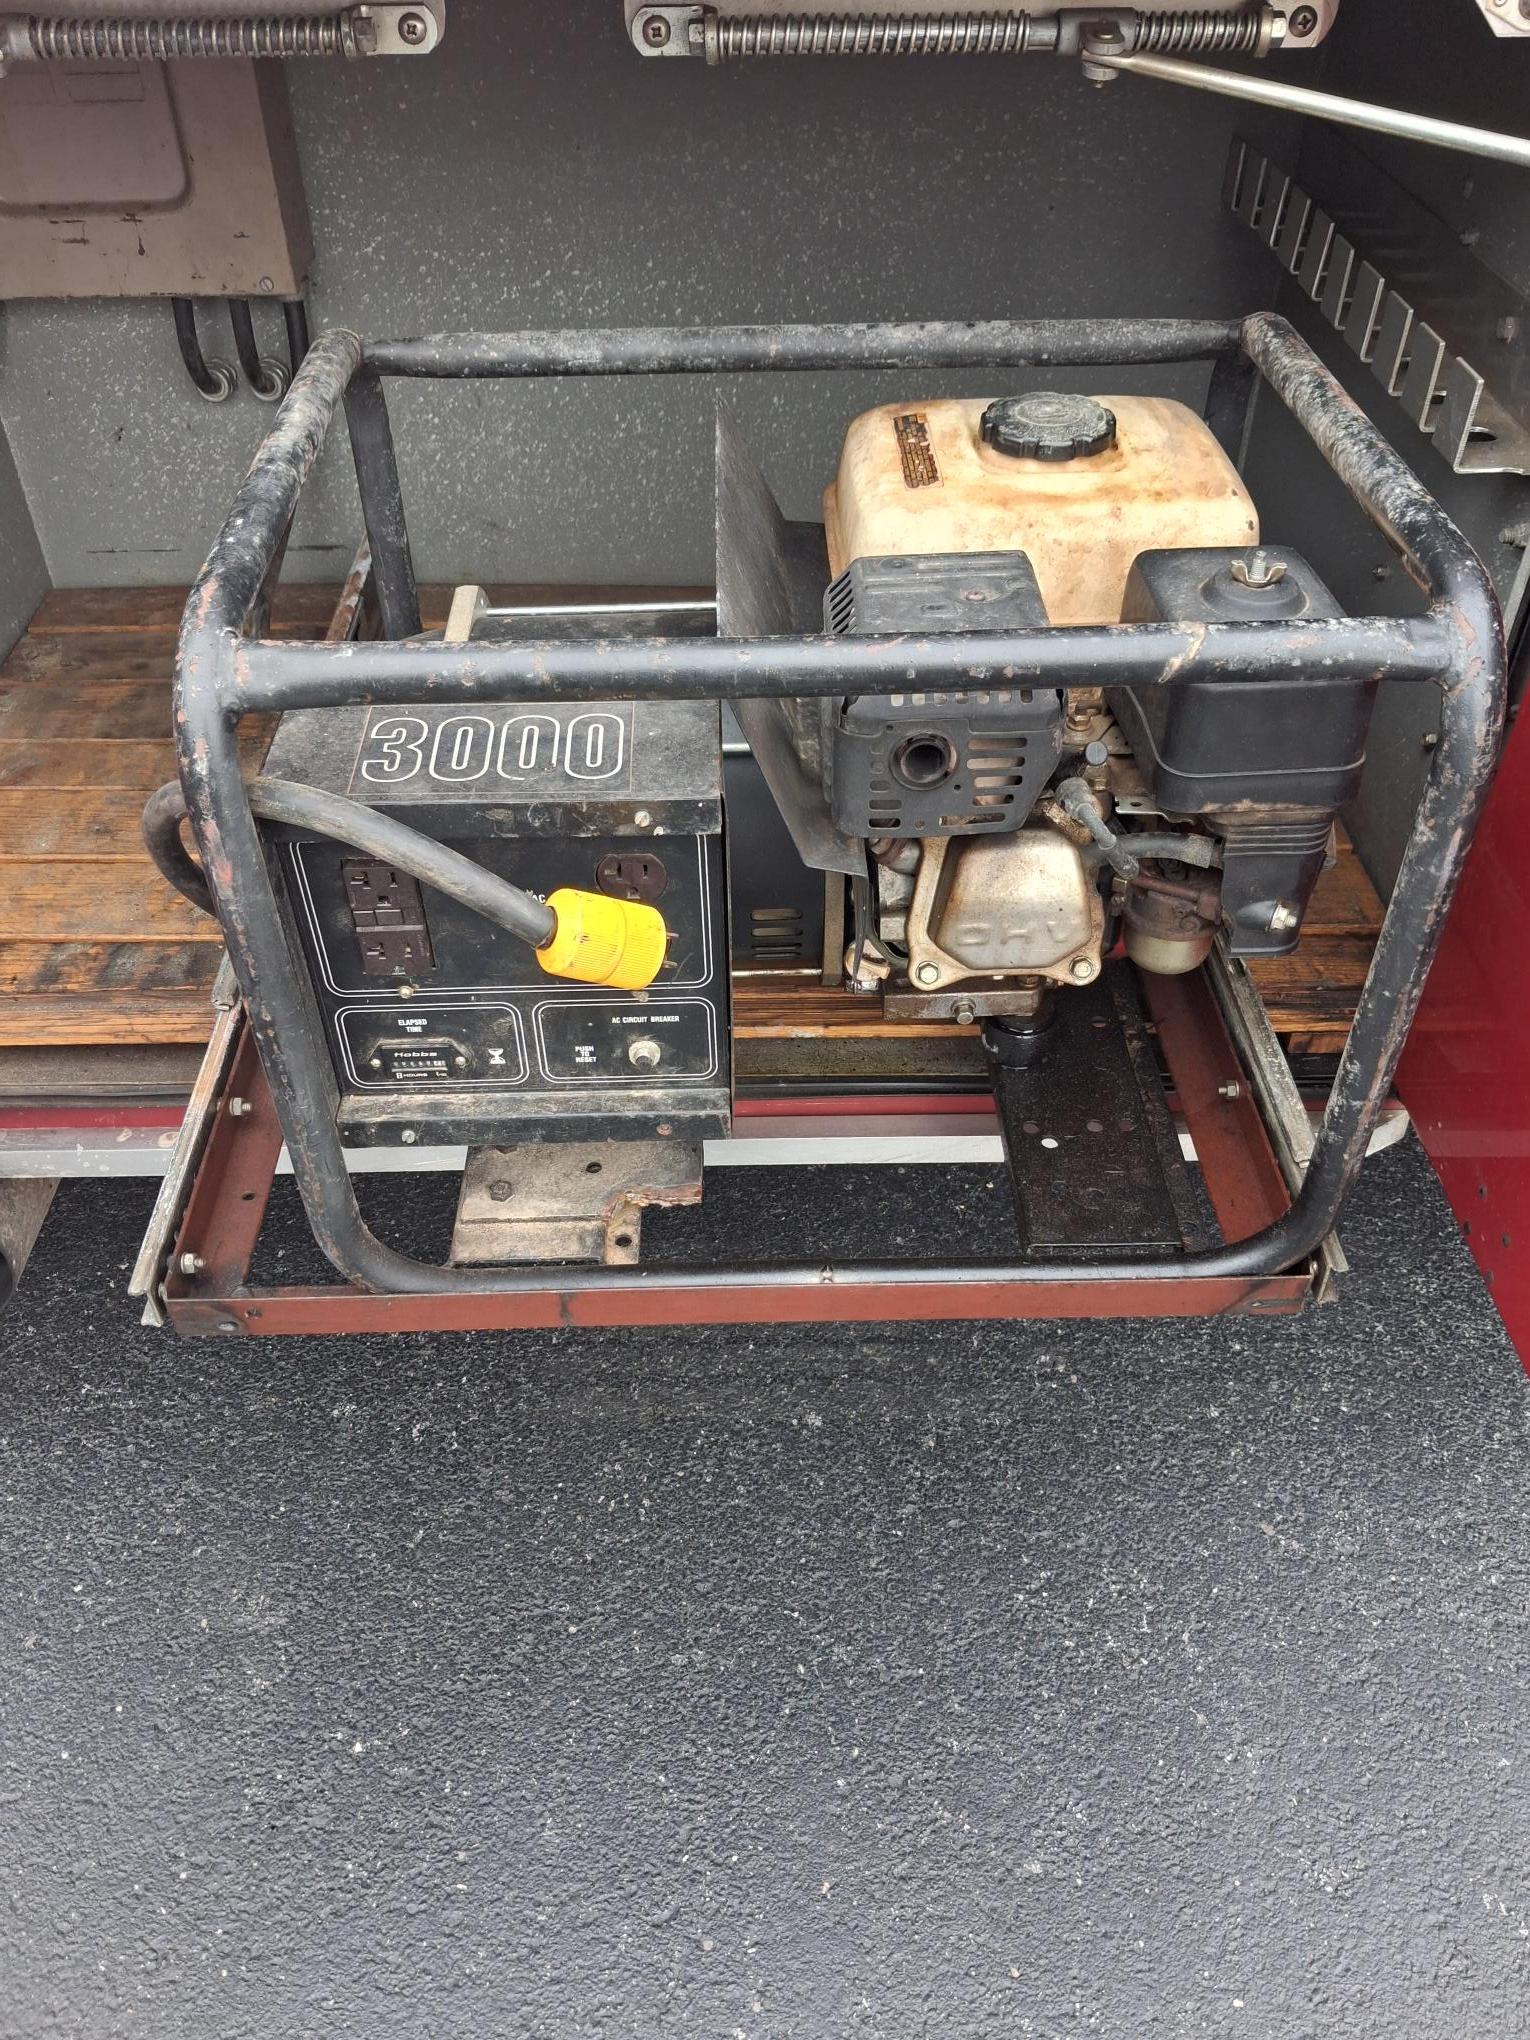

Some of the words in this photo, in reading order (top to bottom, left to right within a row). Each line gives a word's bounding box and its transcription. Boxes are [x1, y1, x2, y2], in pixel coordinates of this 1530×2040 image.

[361, 713, 625, 783] 3000
[954, 920, 1081, 946] OHV
[622, 1016, 648, 1024] CIRCUIT
[650, 1015, 680, 1023] BREAKER
